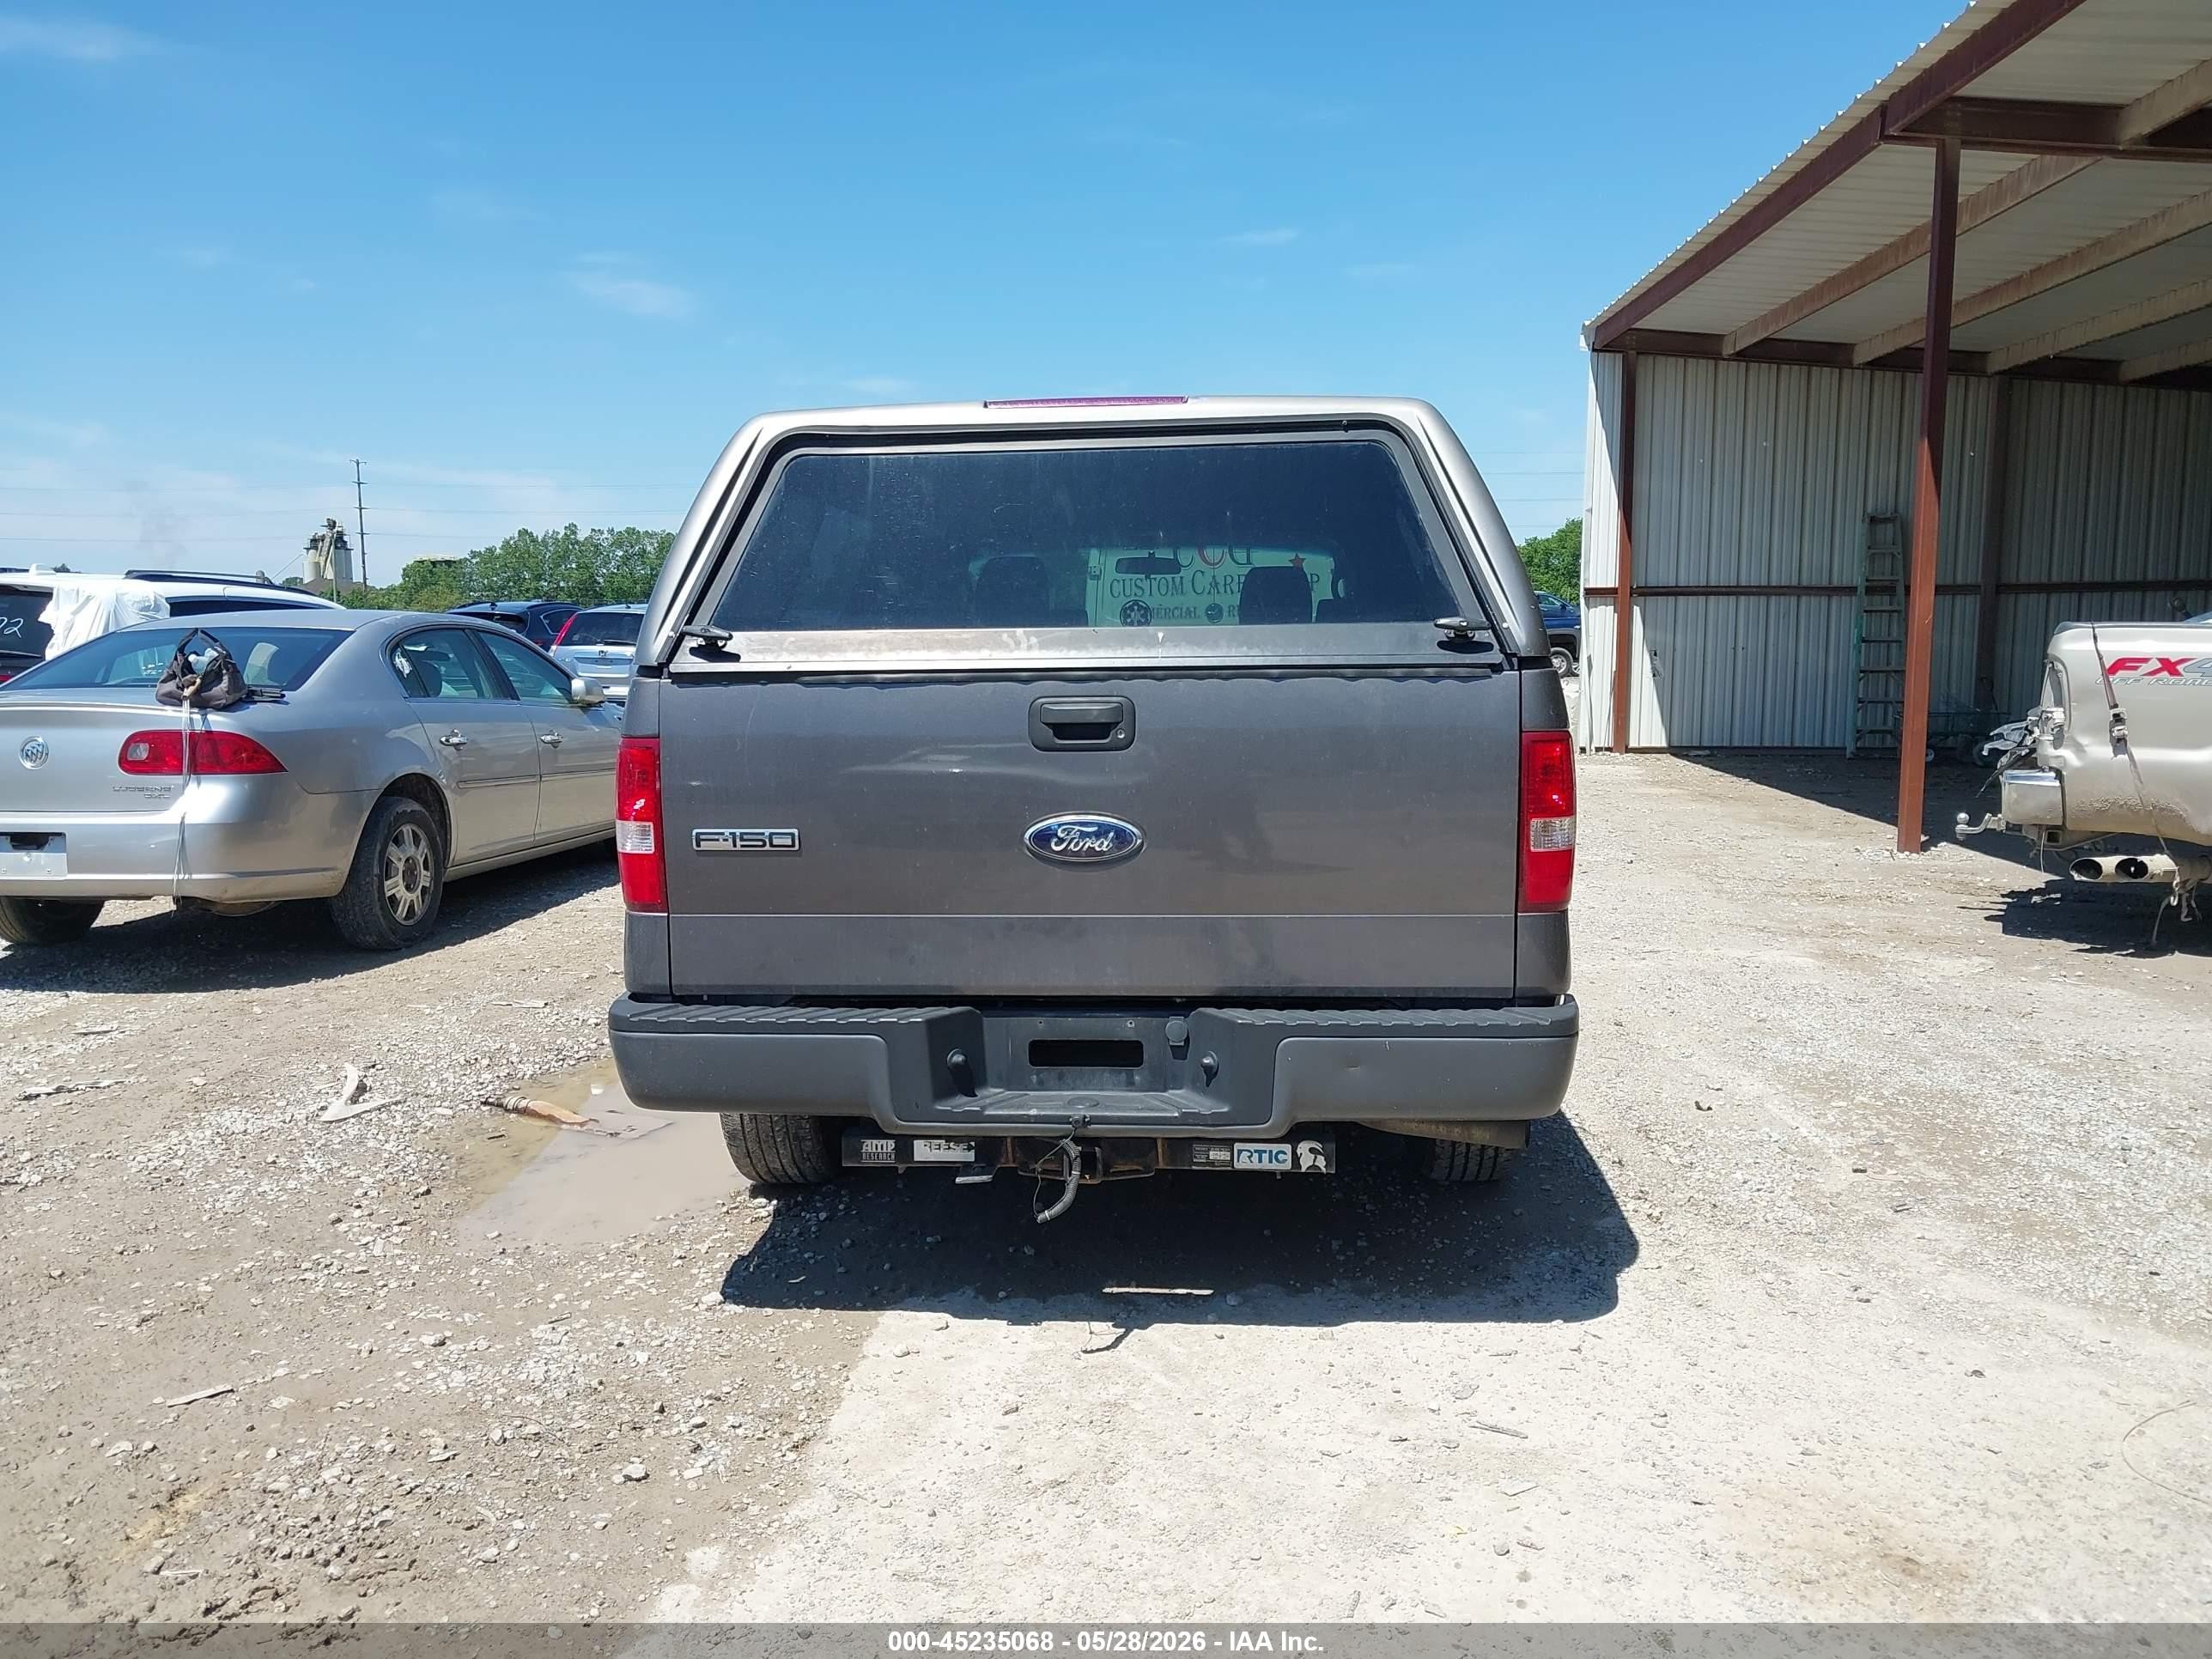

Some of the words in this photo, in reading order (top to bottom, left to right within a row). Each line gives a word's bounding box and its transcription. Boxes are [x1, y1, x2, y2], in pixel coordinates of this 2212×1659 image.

[1109, 576, 1184, 599] CUSTOM
[2106, 657, 2212, 678] FX4
[695, 831, 796, 848] F-150
[1050, 824, 1115, 852] Ford
[860, 1139, 896, 1152] AMP
[922, 1140, 969, 1153] REESE
[861, 1152, 896, 1161] RESEARCH
[1237, 1148, 1288, 1164] RTIC
